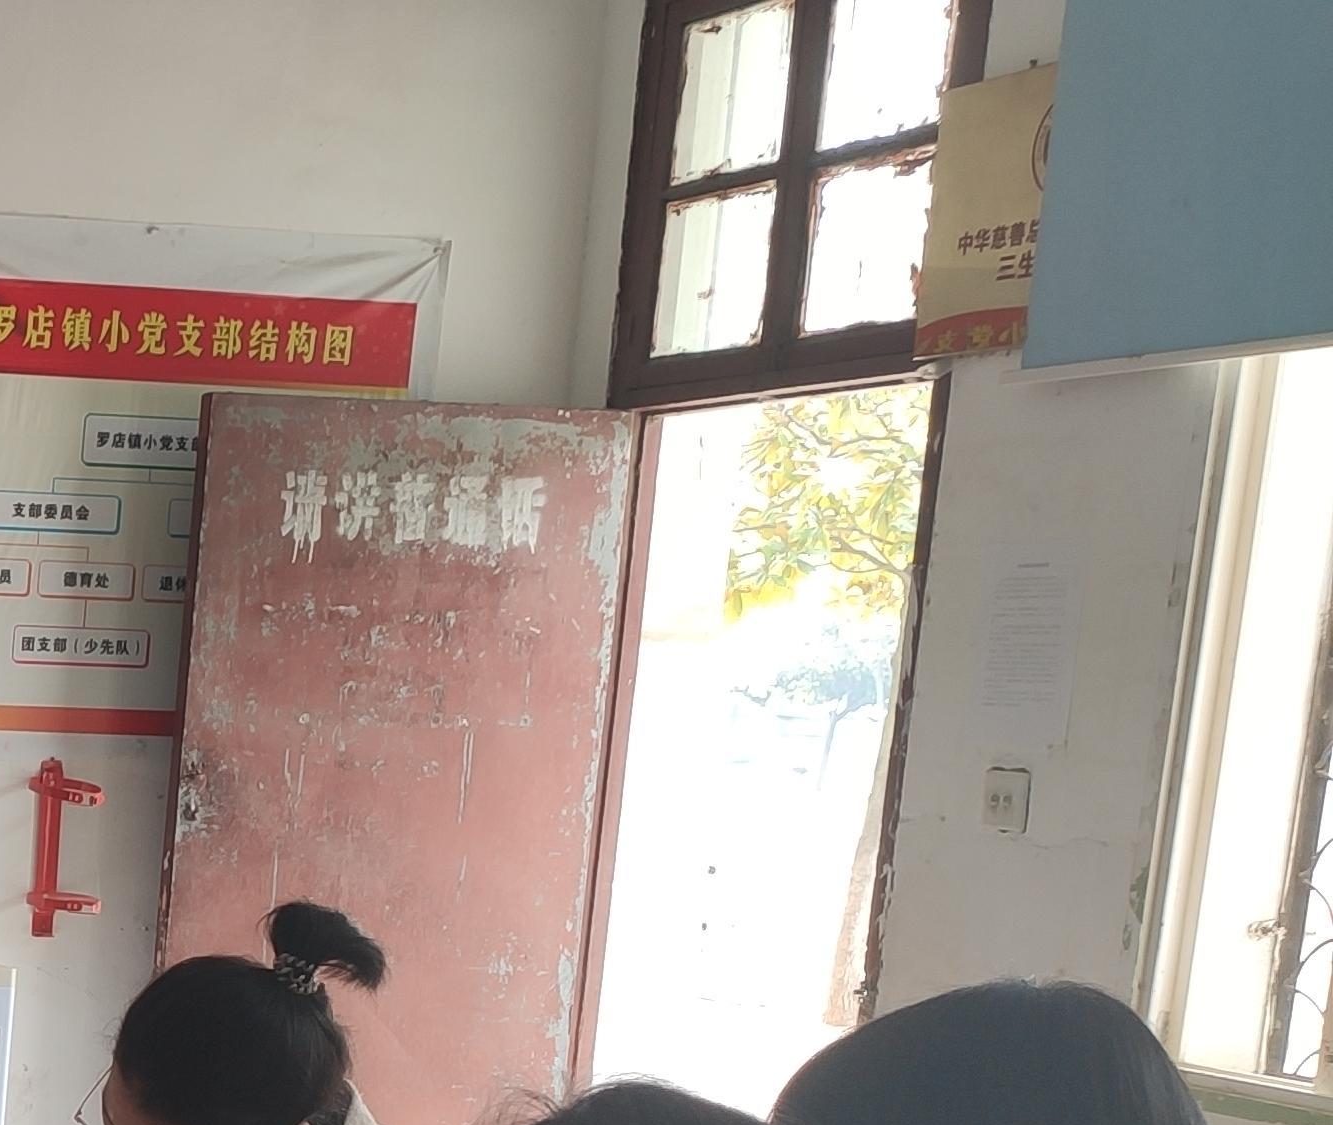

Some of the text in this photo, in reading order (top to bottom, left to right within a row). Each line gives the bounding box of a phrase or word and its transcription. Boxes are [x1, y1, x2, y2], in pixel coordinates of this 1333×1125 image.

[11, 502, 90, 521] 支部委员会
[63, 571, 110, 590] 德育处
